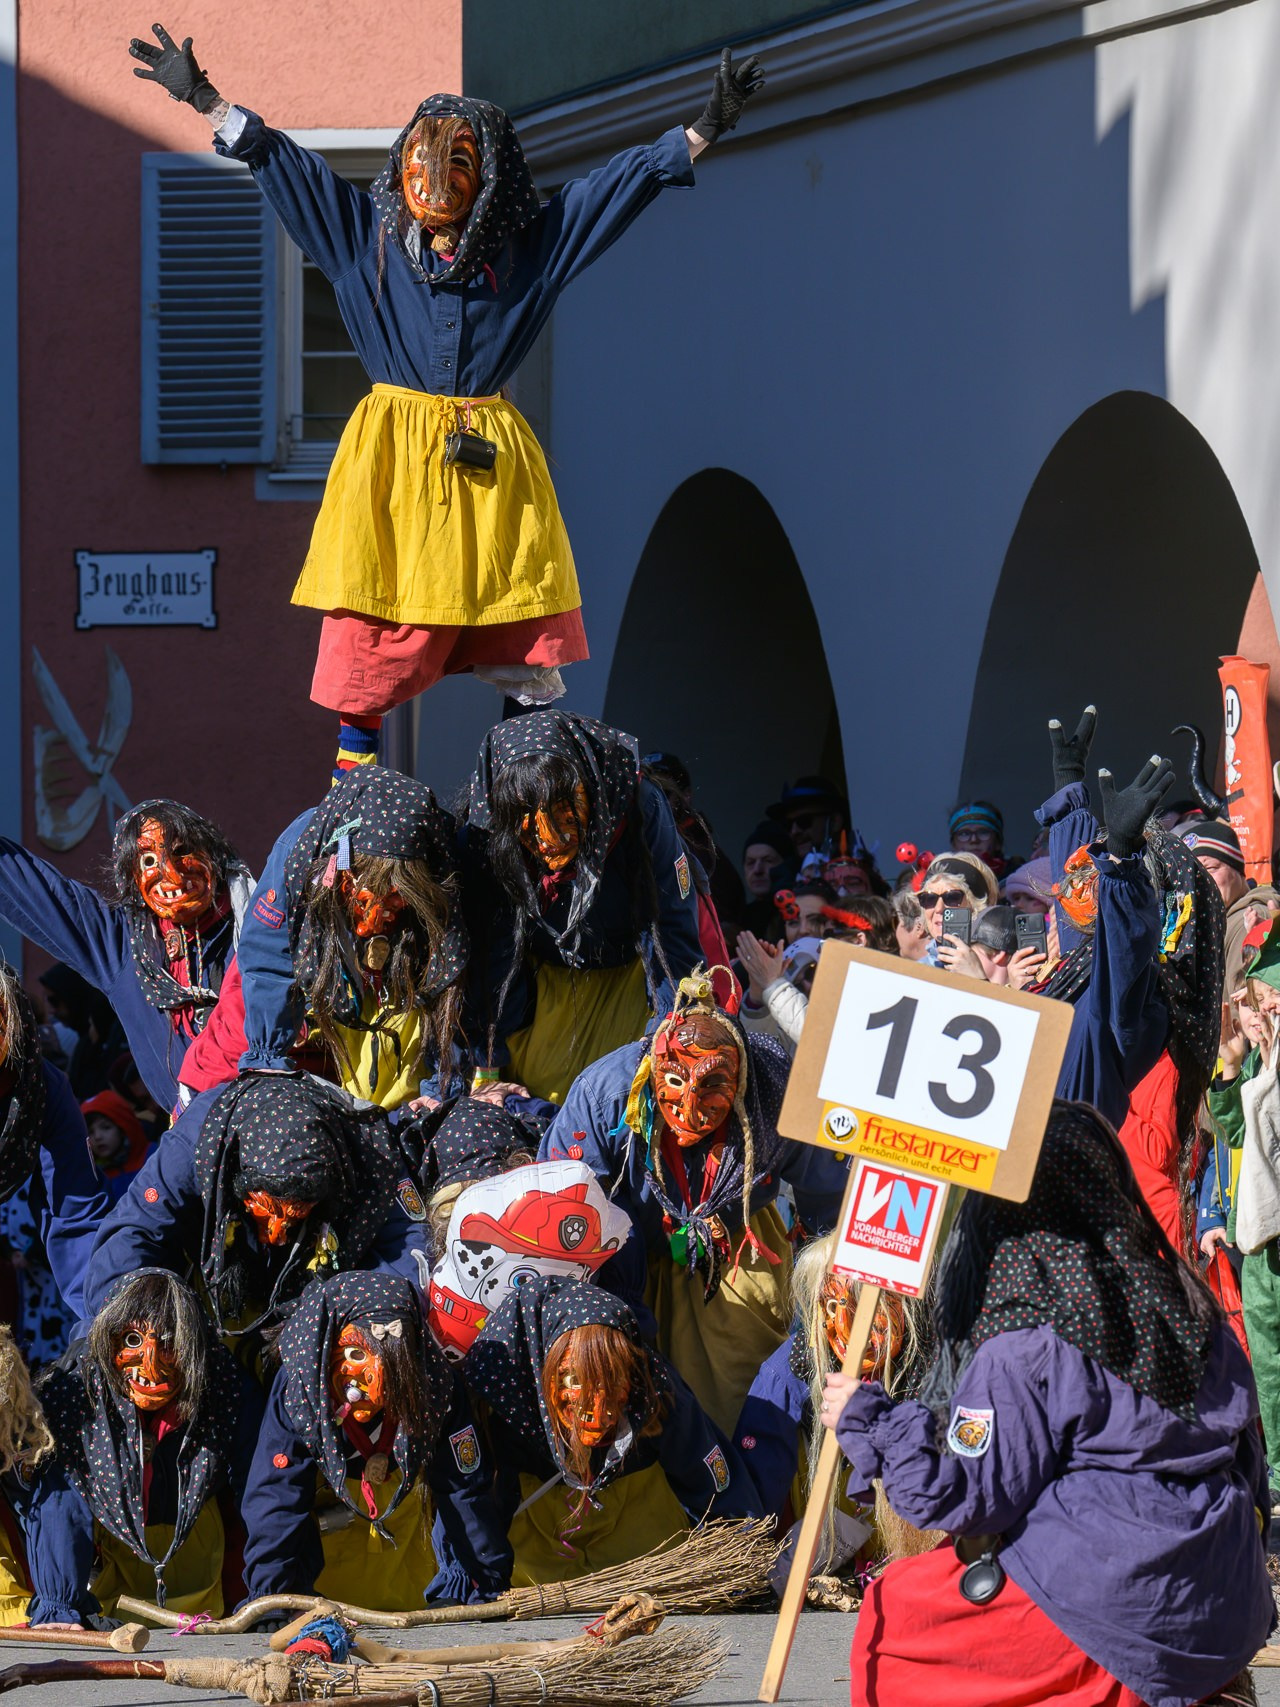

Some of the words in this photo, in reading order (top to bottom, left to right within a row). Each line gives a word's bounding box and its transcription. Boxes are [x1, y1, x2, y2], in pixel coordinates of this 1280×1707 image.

[866, 995, 1001, 1119] 13
[859, 1144, 909, 1164] persönlich
[910, 1157, 930, 1170] und
[931, 1164, 952, 1176] echt
[855, 1170, 933, 1237] VN
[850, 1230, 912, 1255] NACHRICHTEN
[853, 1221, 920, 1247] VORARLBERGER
